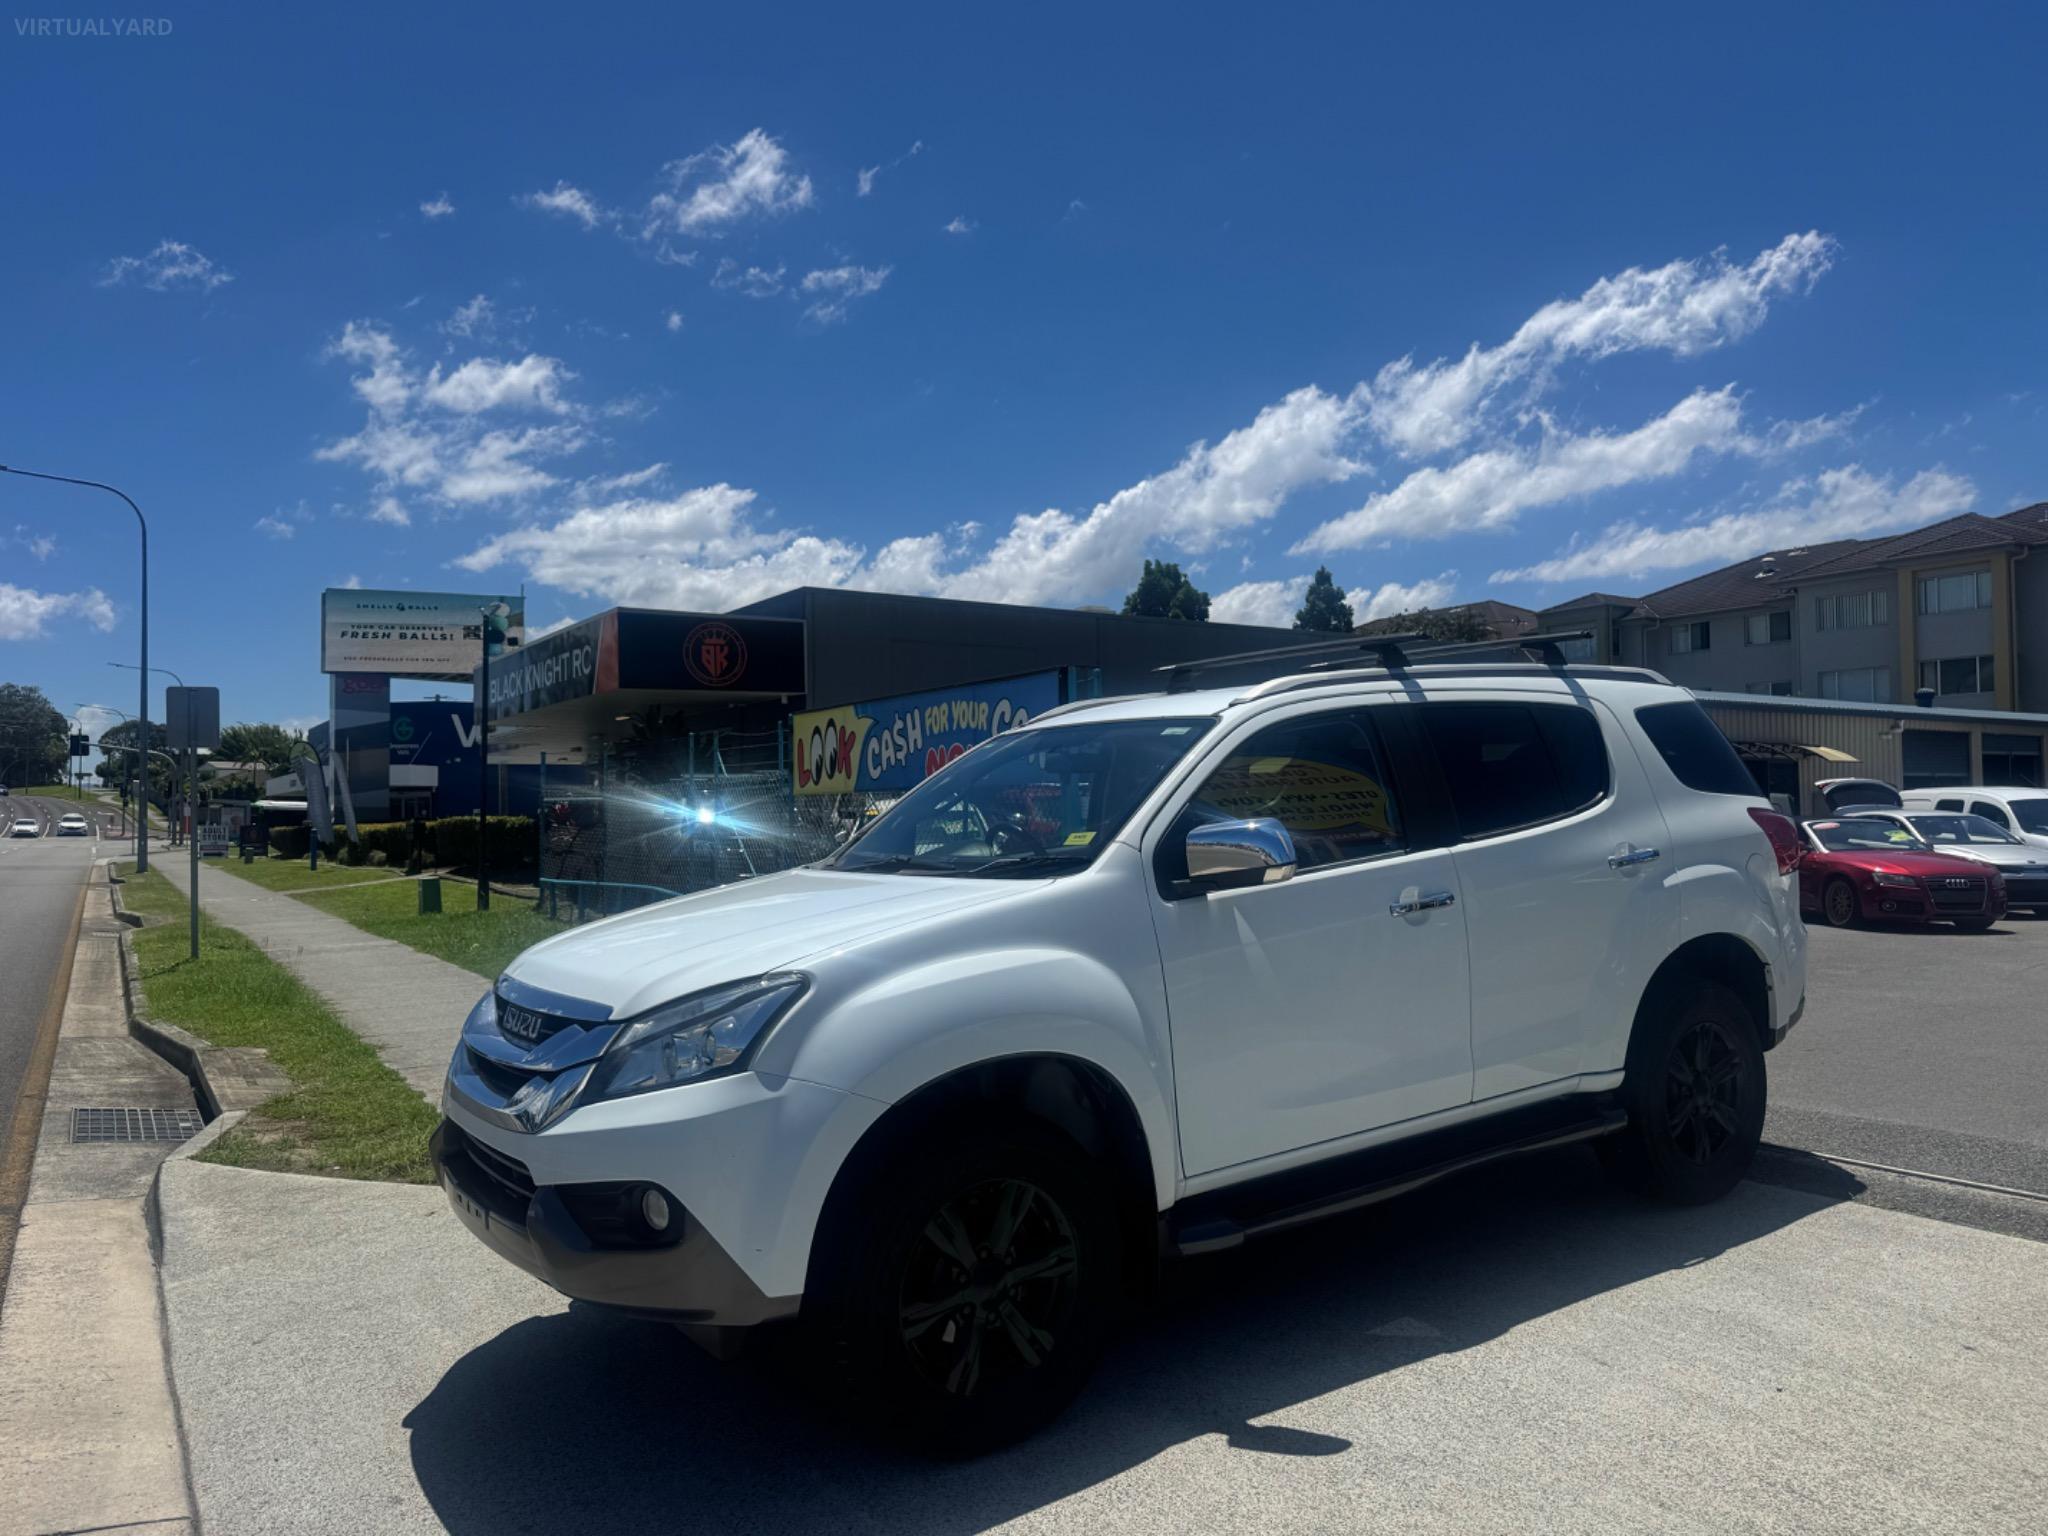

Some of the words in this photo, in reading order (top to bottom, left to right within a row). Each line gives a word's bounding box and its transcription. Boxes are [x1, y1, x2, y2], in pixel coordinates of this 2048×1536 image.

[340, 631, 391, 639] FRESH
[399, 632, 454, 641] BALLS!
[489, 669, 523, 703] BLACK
[524, 652, 570, 691] KNIGHT
[572, 645, 591, 678] RC
[798, 718, 856, 788] LOOK
[925, 702, 949, 736] FOR
[951, 700, 989, 731] YOUR
[503, 1006, 542, 1039] ISUZU
